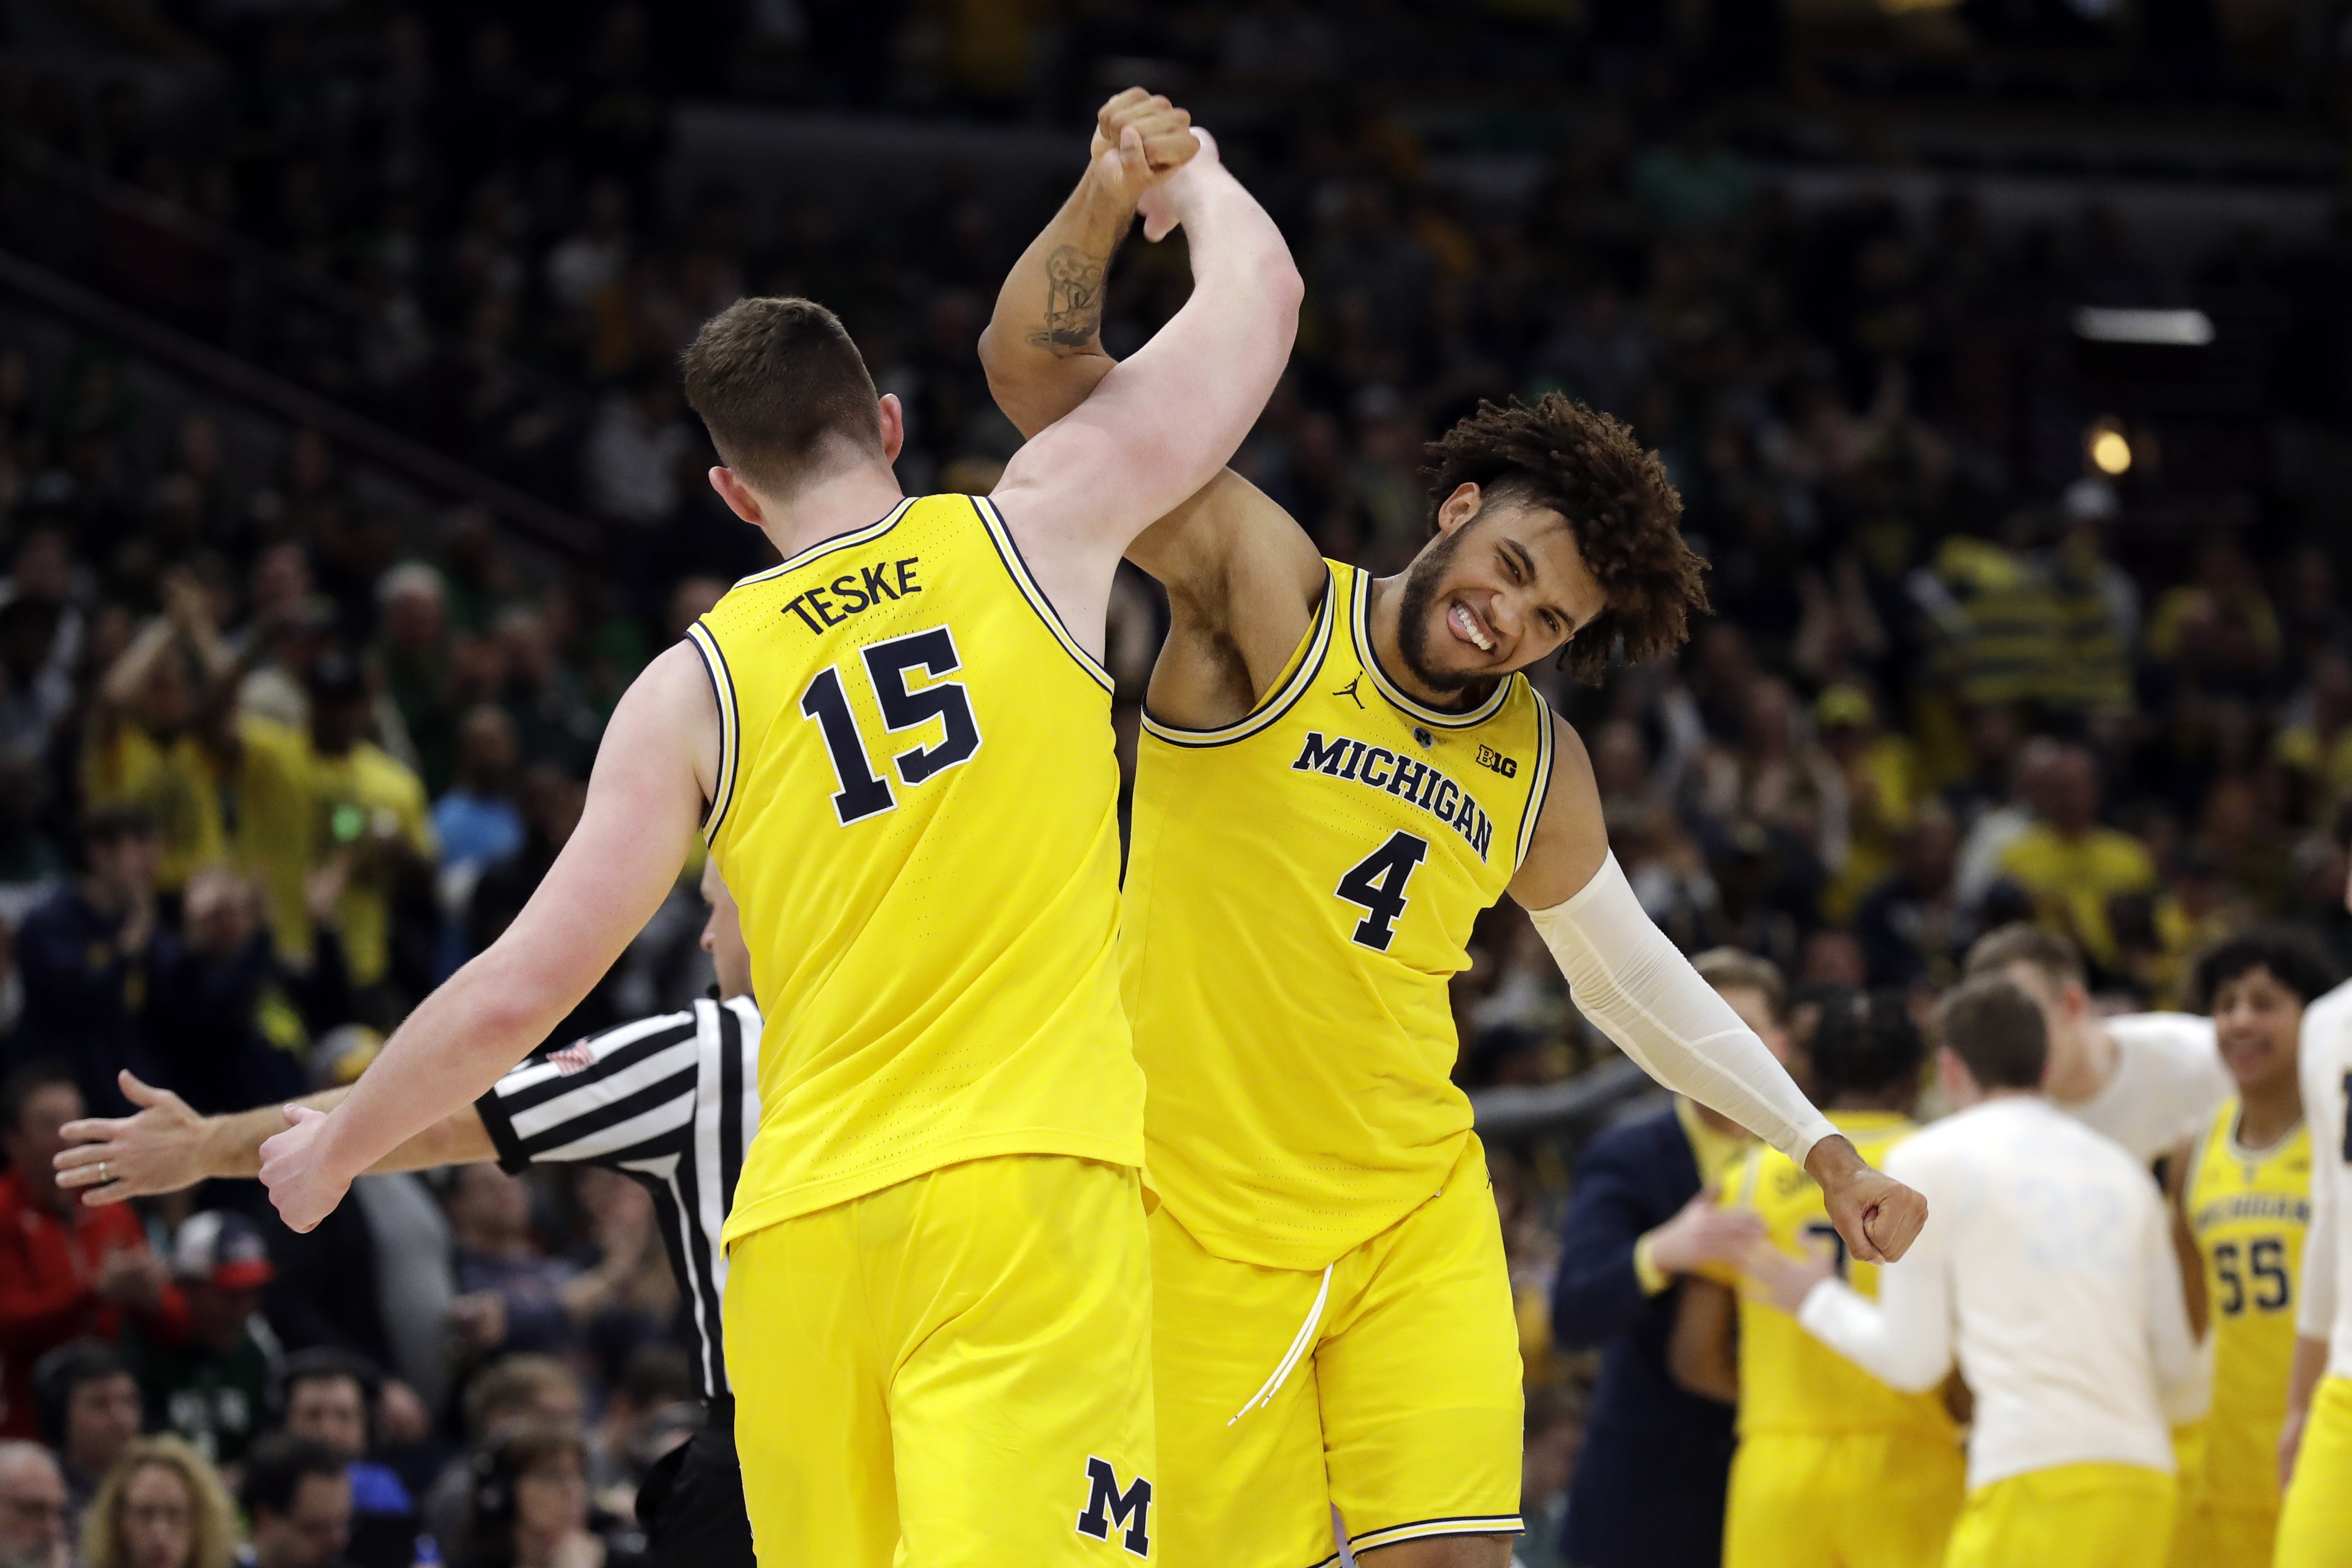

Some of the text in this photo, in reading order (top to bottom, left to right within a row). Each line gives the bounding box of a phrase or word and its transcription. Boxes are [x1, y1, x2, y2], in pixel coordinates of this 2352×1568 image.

[781, 557, 922, 635] TESKE
[799, 623, 983, 828] 15
[1290, 730, 1493, 866] MICHIGAN
[1333, 828, 1430, 953] 4
[2213, 1239, 2291, 1316] 55
[1075, 1454, 1153, 1560] M
